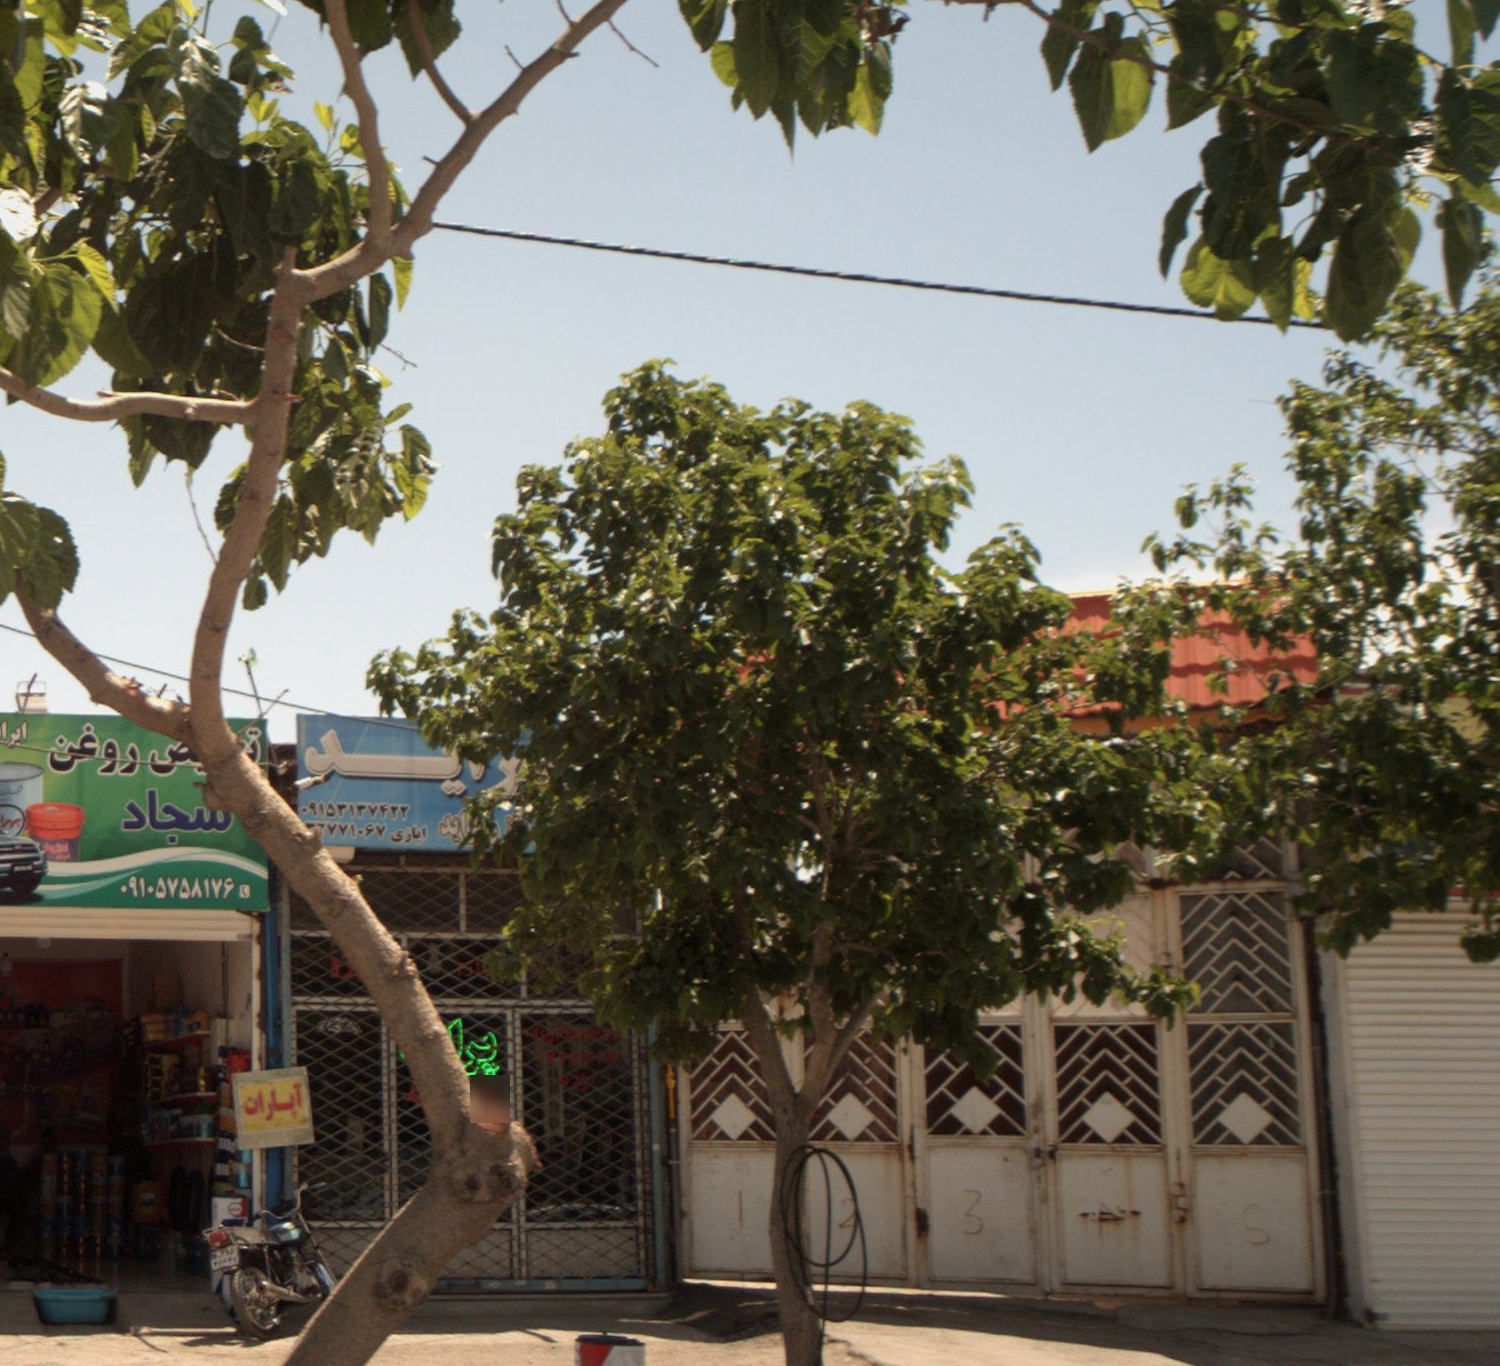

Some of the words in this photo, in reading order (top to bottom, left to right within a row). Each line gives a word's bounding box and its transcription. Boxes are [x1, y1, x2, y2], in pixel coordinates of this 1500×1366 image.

[48, 722, 140, 776] روغن
[121, 787, 233, 845] سجاد
[119, 875, 235, 900] ۰۹۱۰۵۷۵۸۱۷۶
